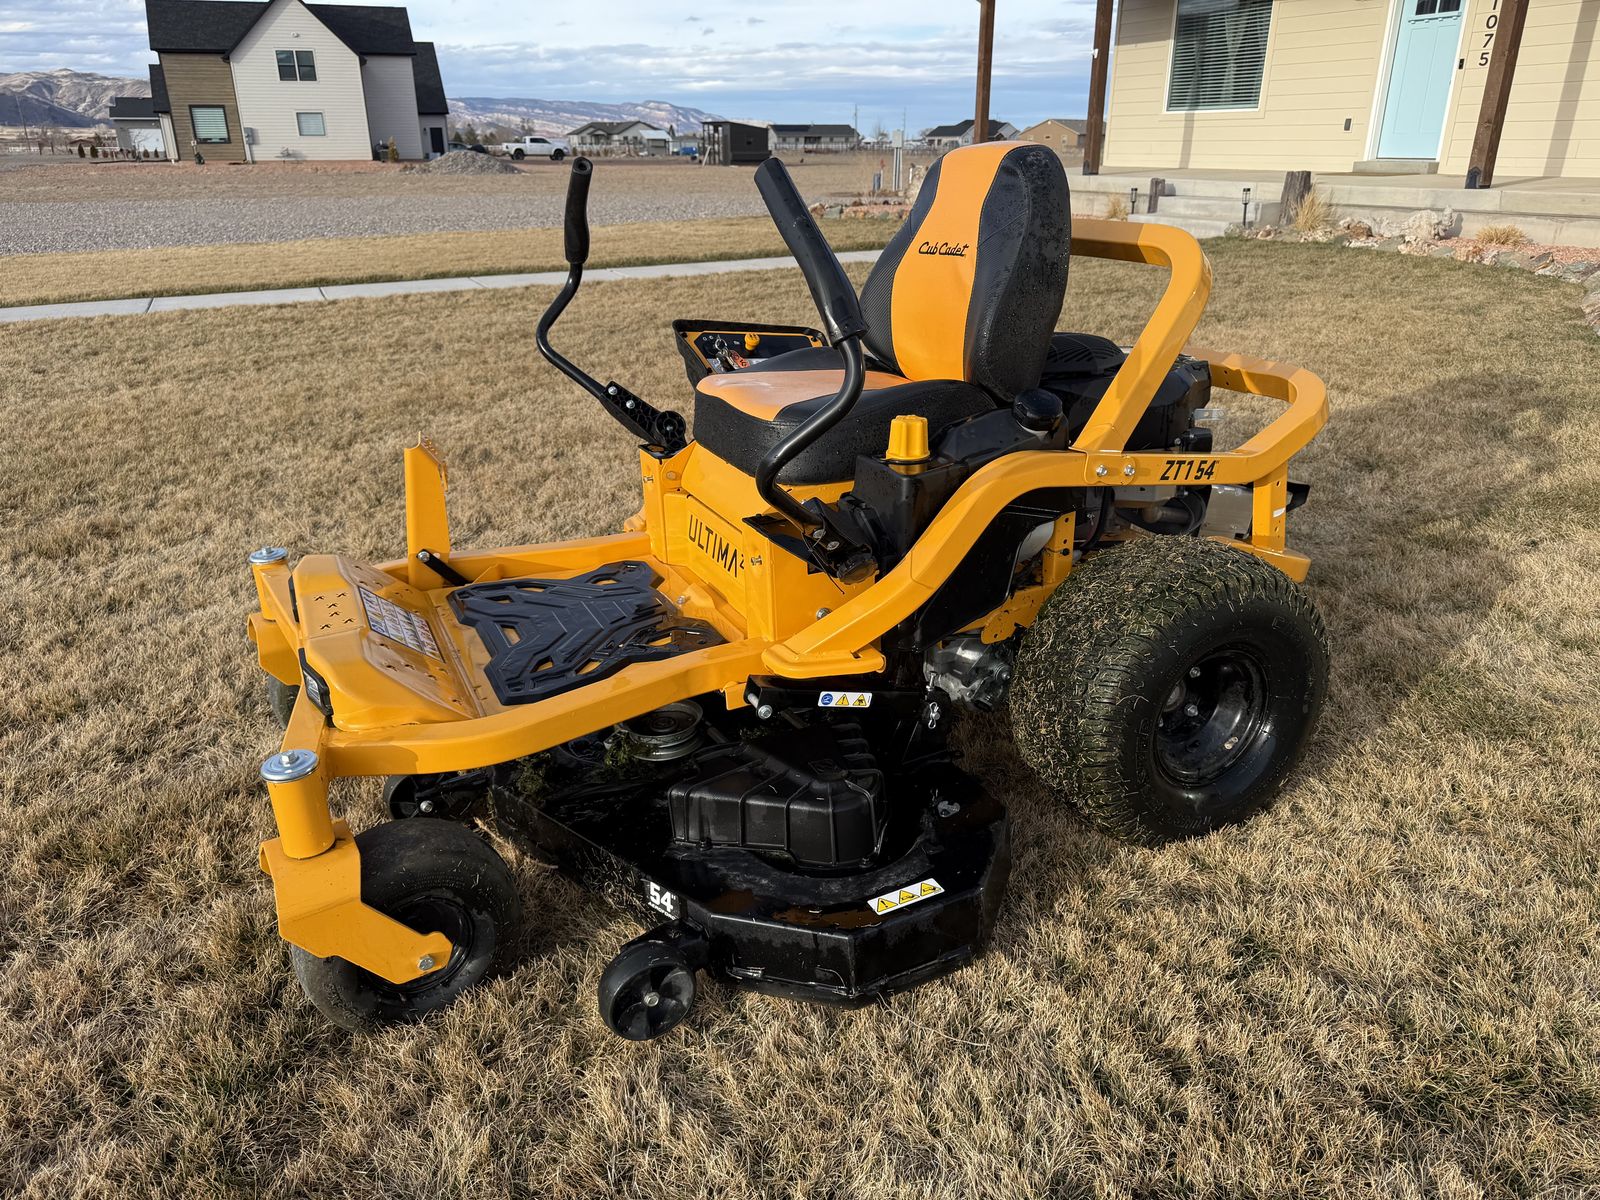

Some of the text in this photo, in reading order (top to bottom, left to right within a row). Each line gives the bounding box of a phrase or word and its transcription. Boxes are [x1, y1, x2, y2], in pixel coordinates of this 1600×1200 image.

[918, 241, 969, 257] Cub Cadet
[1159, 460, 1195, 480] ZT1
[688, 514, 737, 578] ULTIMA
